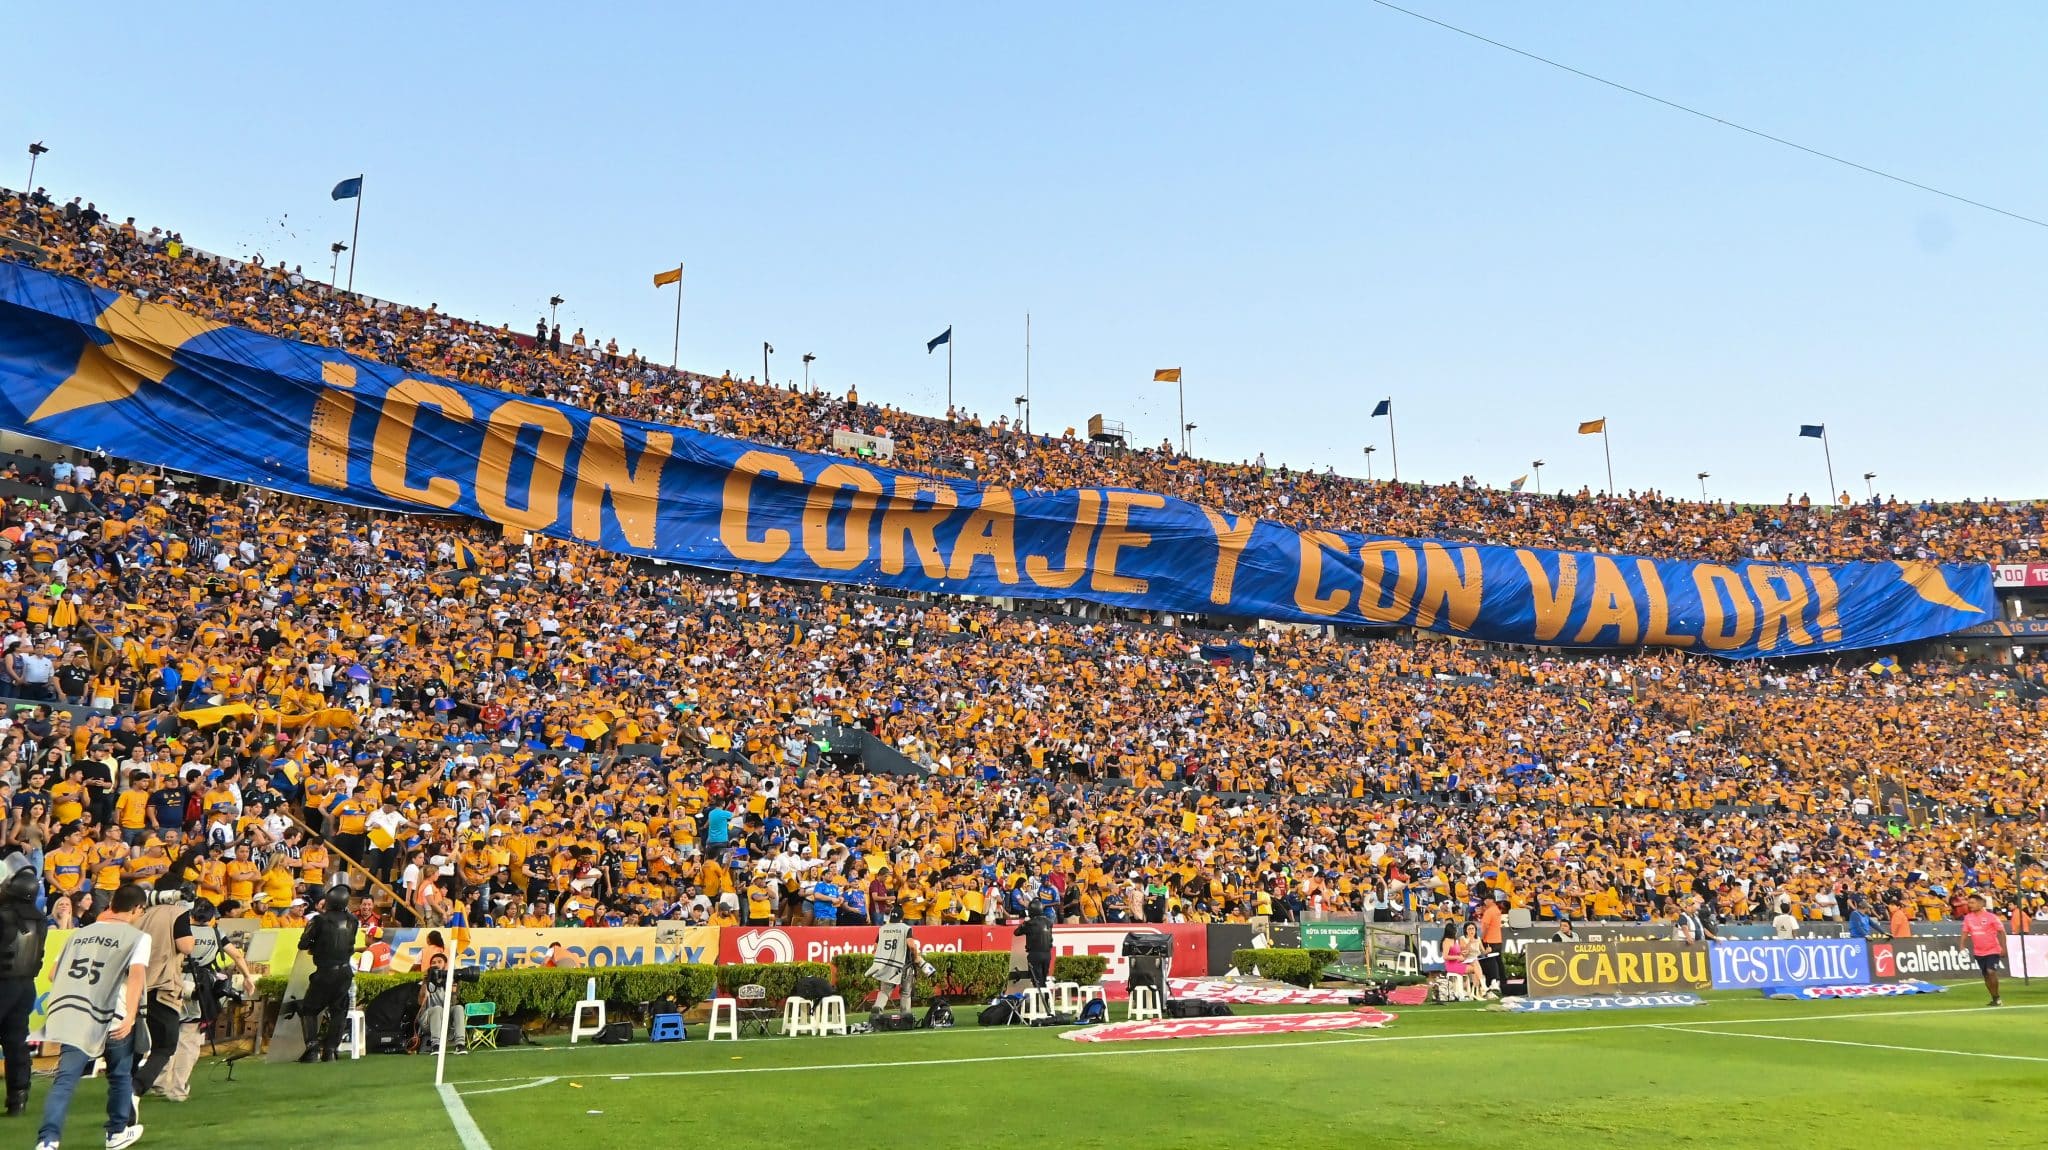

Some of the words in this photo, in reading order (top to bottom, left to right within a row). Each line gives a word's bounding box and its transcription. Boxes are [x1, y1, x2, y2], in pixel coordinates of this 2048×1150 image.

[719, 450, 1166, 594] CORAJE
[1200, 504, 1261, 605] Y
[1293, 530, 1483, 632] CON
[1516, 549, 1843, 651] VALOR!
[73, 936, 119, 949] PRENSA
[884, 939, 898, 950] 58
[1574, 944, 1606, 953] CALZADO
[68, 957, 105, 985] 55
[1569, 951, 1708, 986] CARIBU
